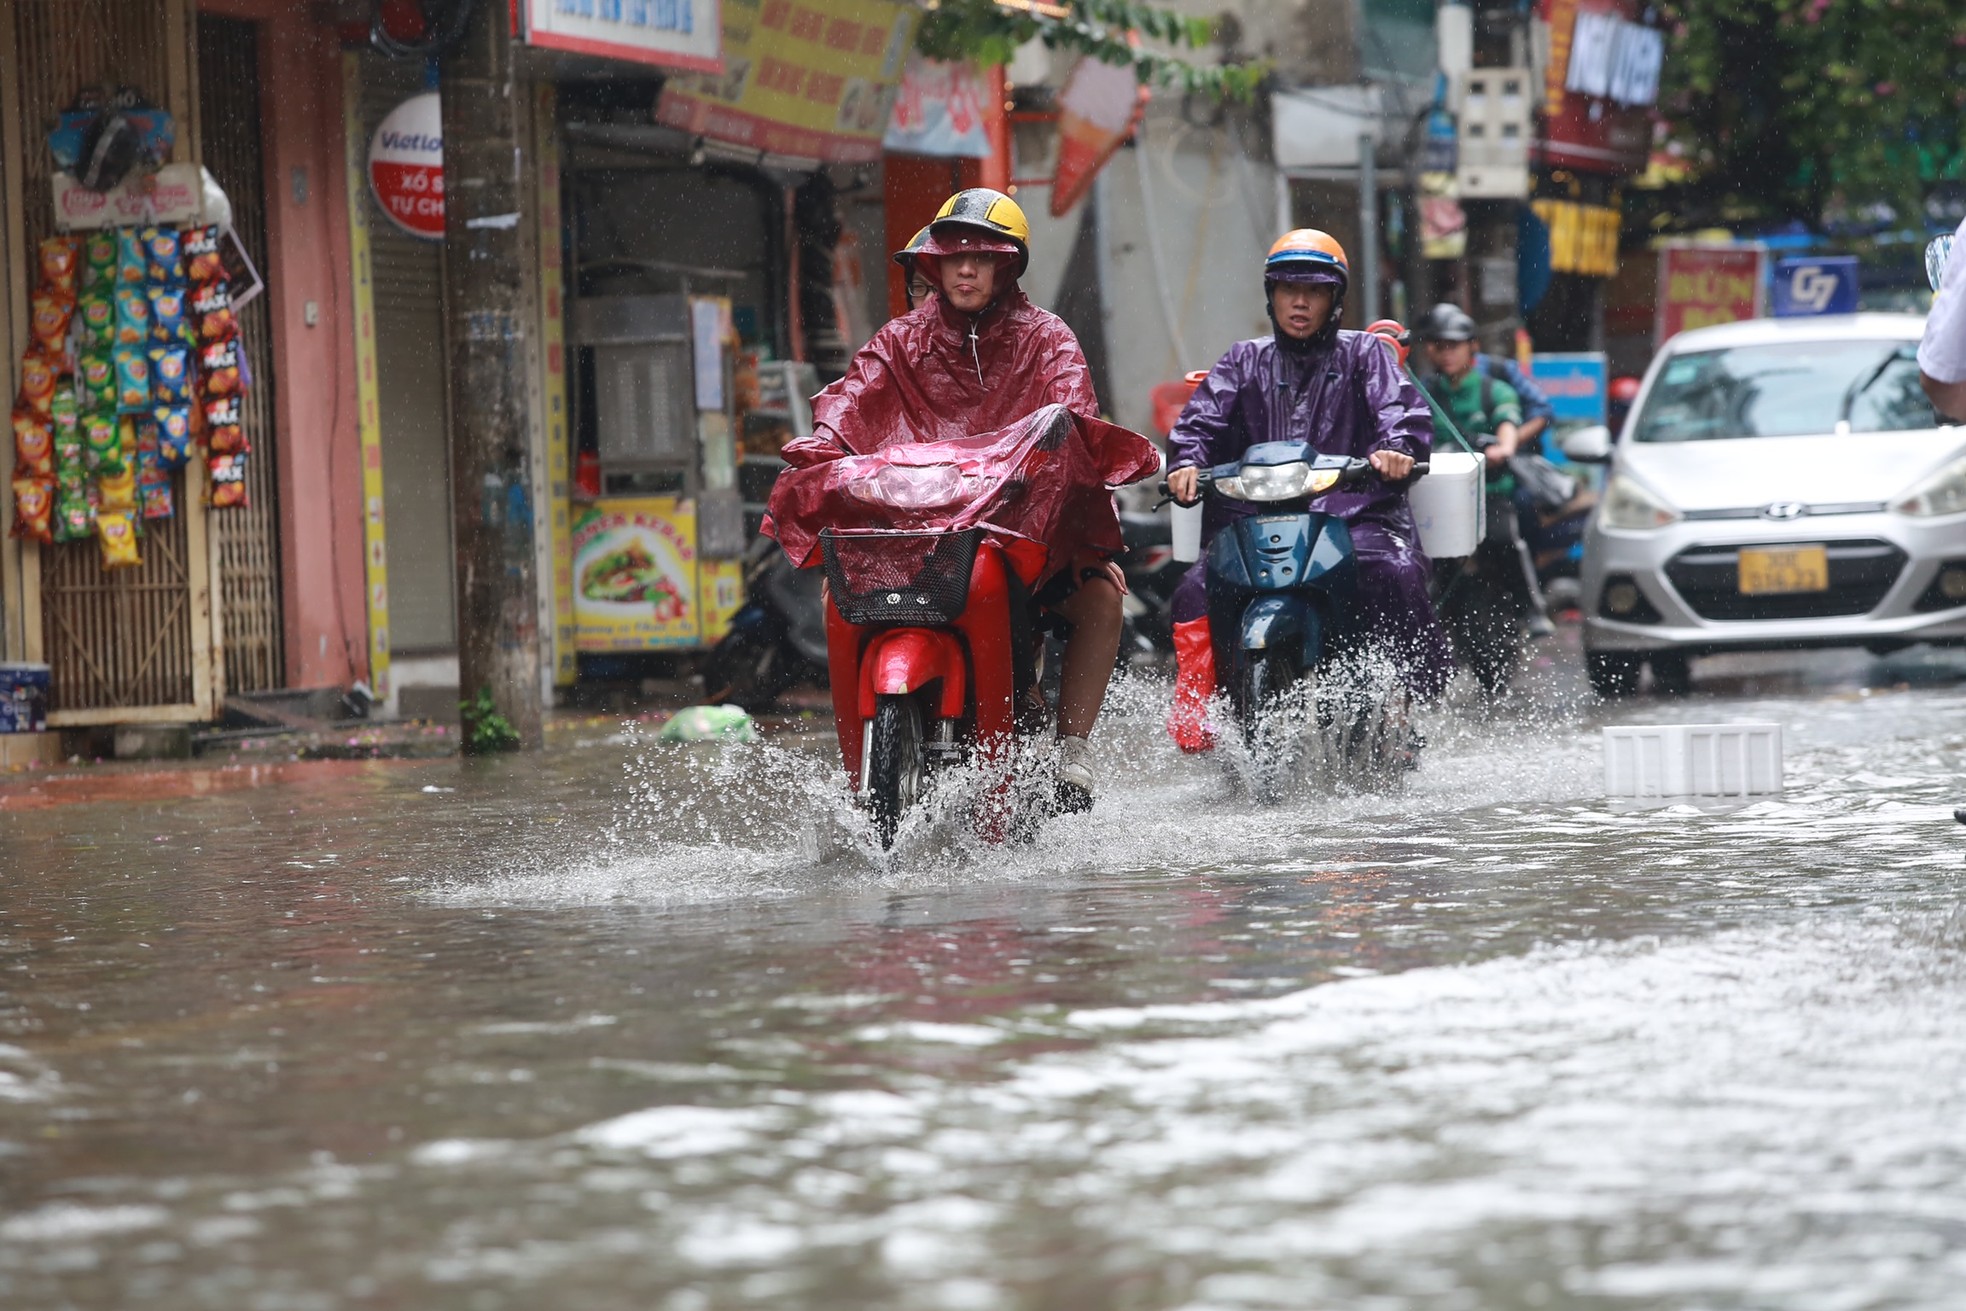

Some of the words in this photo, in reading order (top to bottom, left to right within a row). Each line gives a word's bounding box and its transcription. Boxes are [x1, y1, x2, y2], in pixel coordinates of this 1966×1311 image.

[184, 236, 218, 254] MAX
[194, 293, 229, 313] MAX
[203, 351, 237, 369] MAX
[207, 408, 239, 425] MAX
[211, 464, 244, 482] MAX
